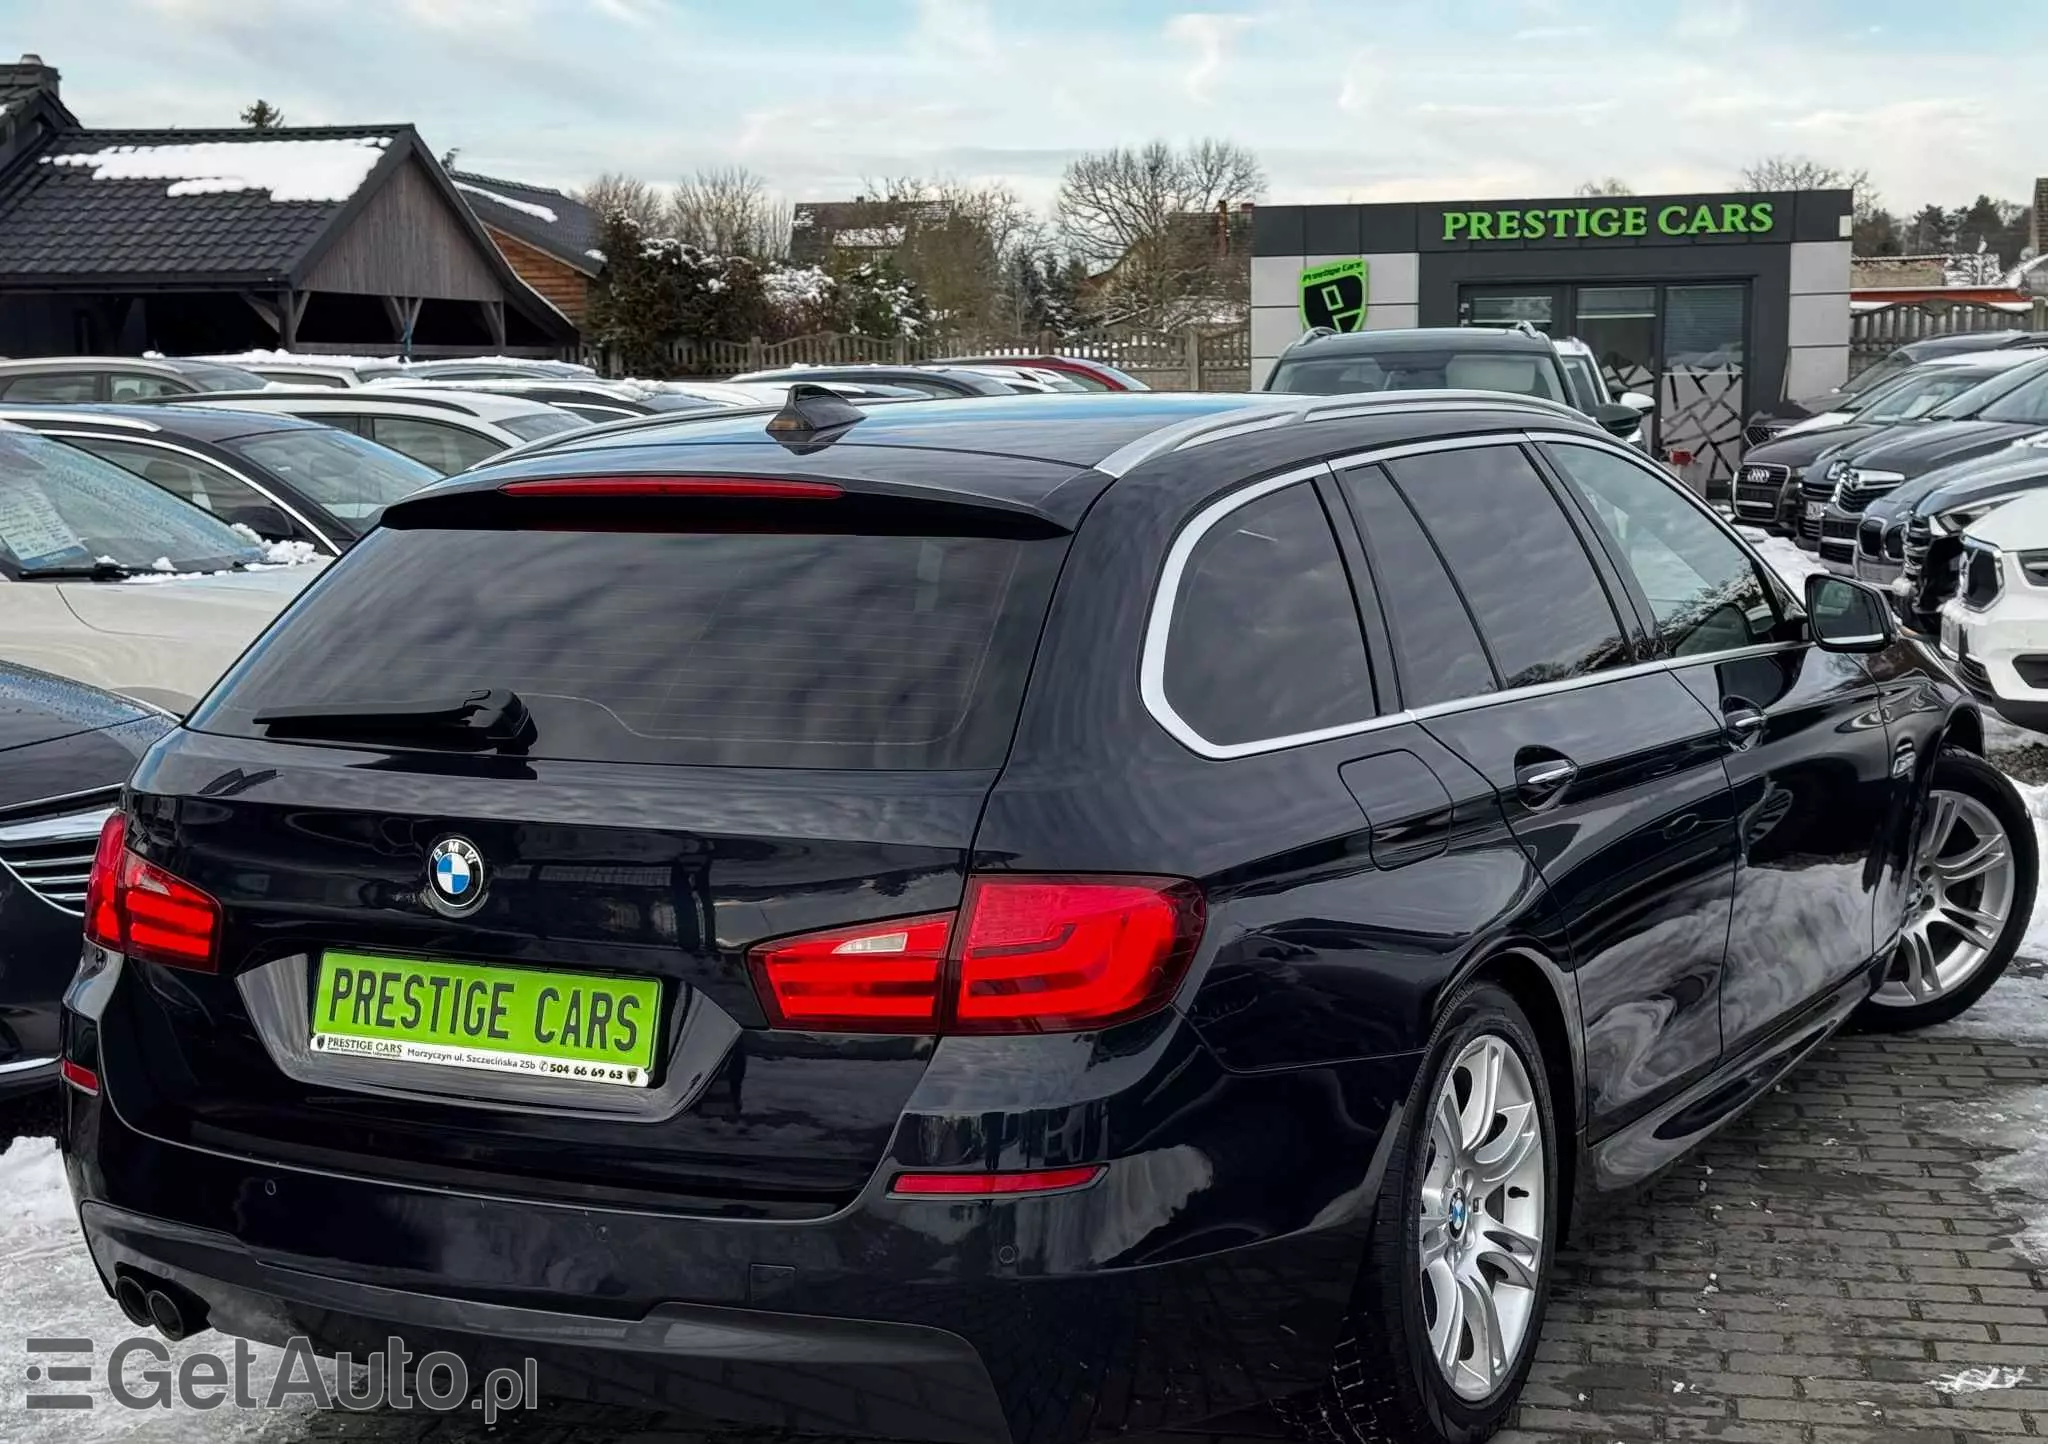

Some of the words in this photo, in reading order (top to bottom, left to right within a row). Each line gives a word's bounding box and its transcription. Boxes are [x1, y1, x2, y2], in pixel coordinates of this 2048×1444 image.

[1441, 206, 1648, 240] PRESTIGE
[1658, 203, 1774, 236] CARS
[328, 967, 515, 1040] PRESTIGE
[534, 986, 640, 1052] CARS
[327, 1036, 373, 1051] PRESTIGE
[375, 1042, 402, 1053] CARS
[407, 1047, 452, 1061] Morzyczyn
[454, 1052, 464, 1062] ul.
[466, 1054, 518, 1067] Szczecińska
[520, 1059, 536, 1070] 25b
[549, 1063, 569, 1074] 504
[573, 1066, 587, 1076] 66
[591, 1067, 605, 1078] 69
[609, 1069, 623, 1080] 63
